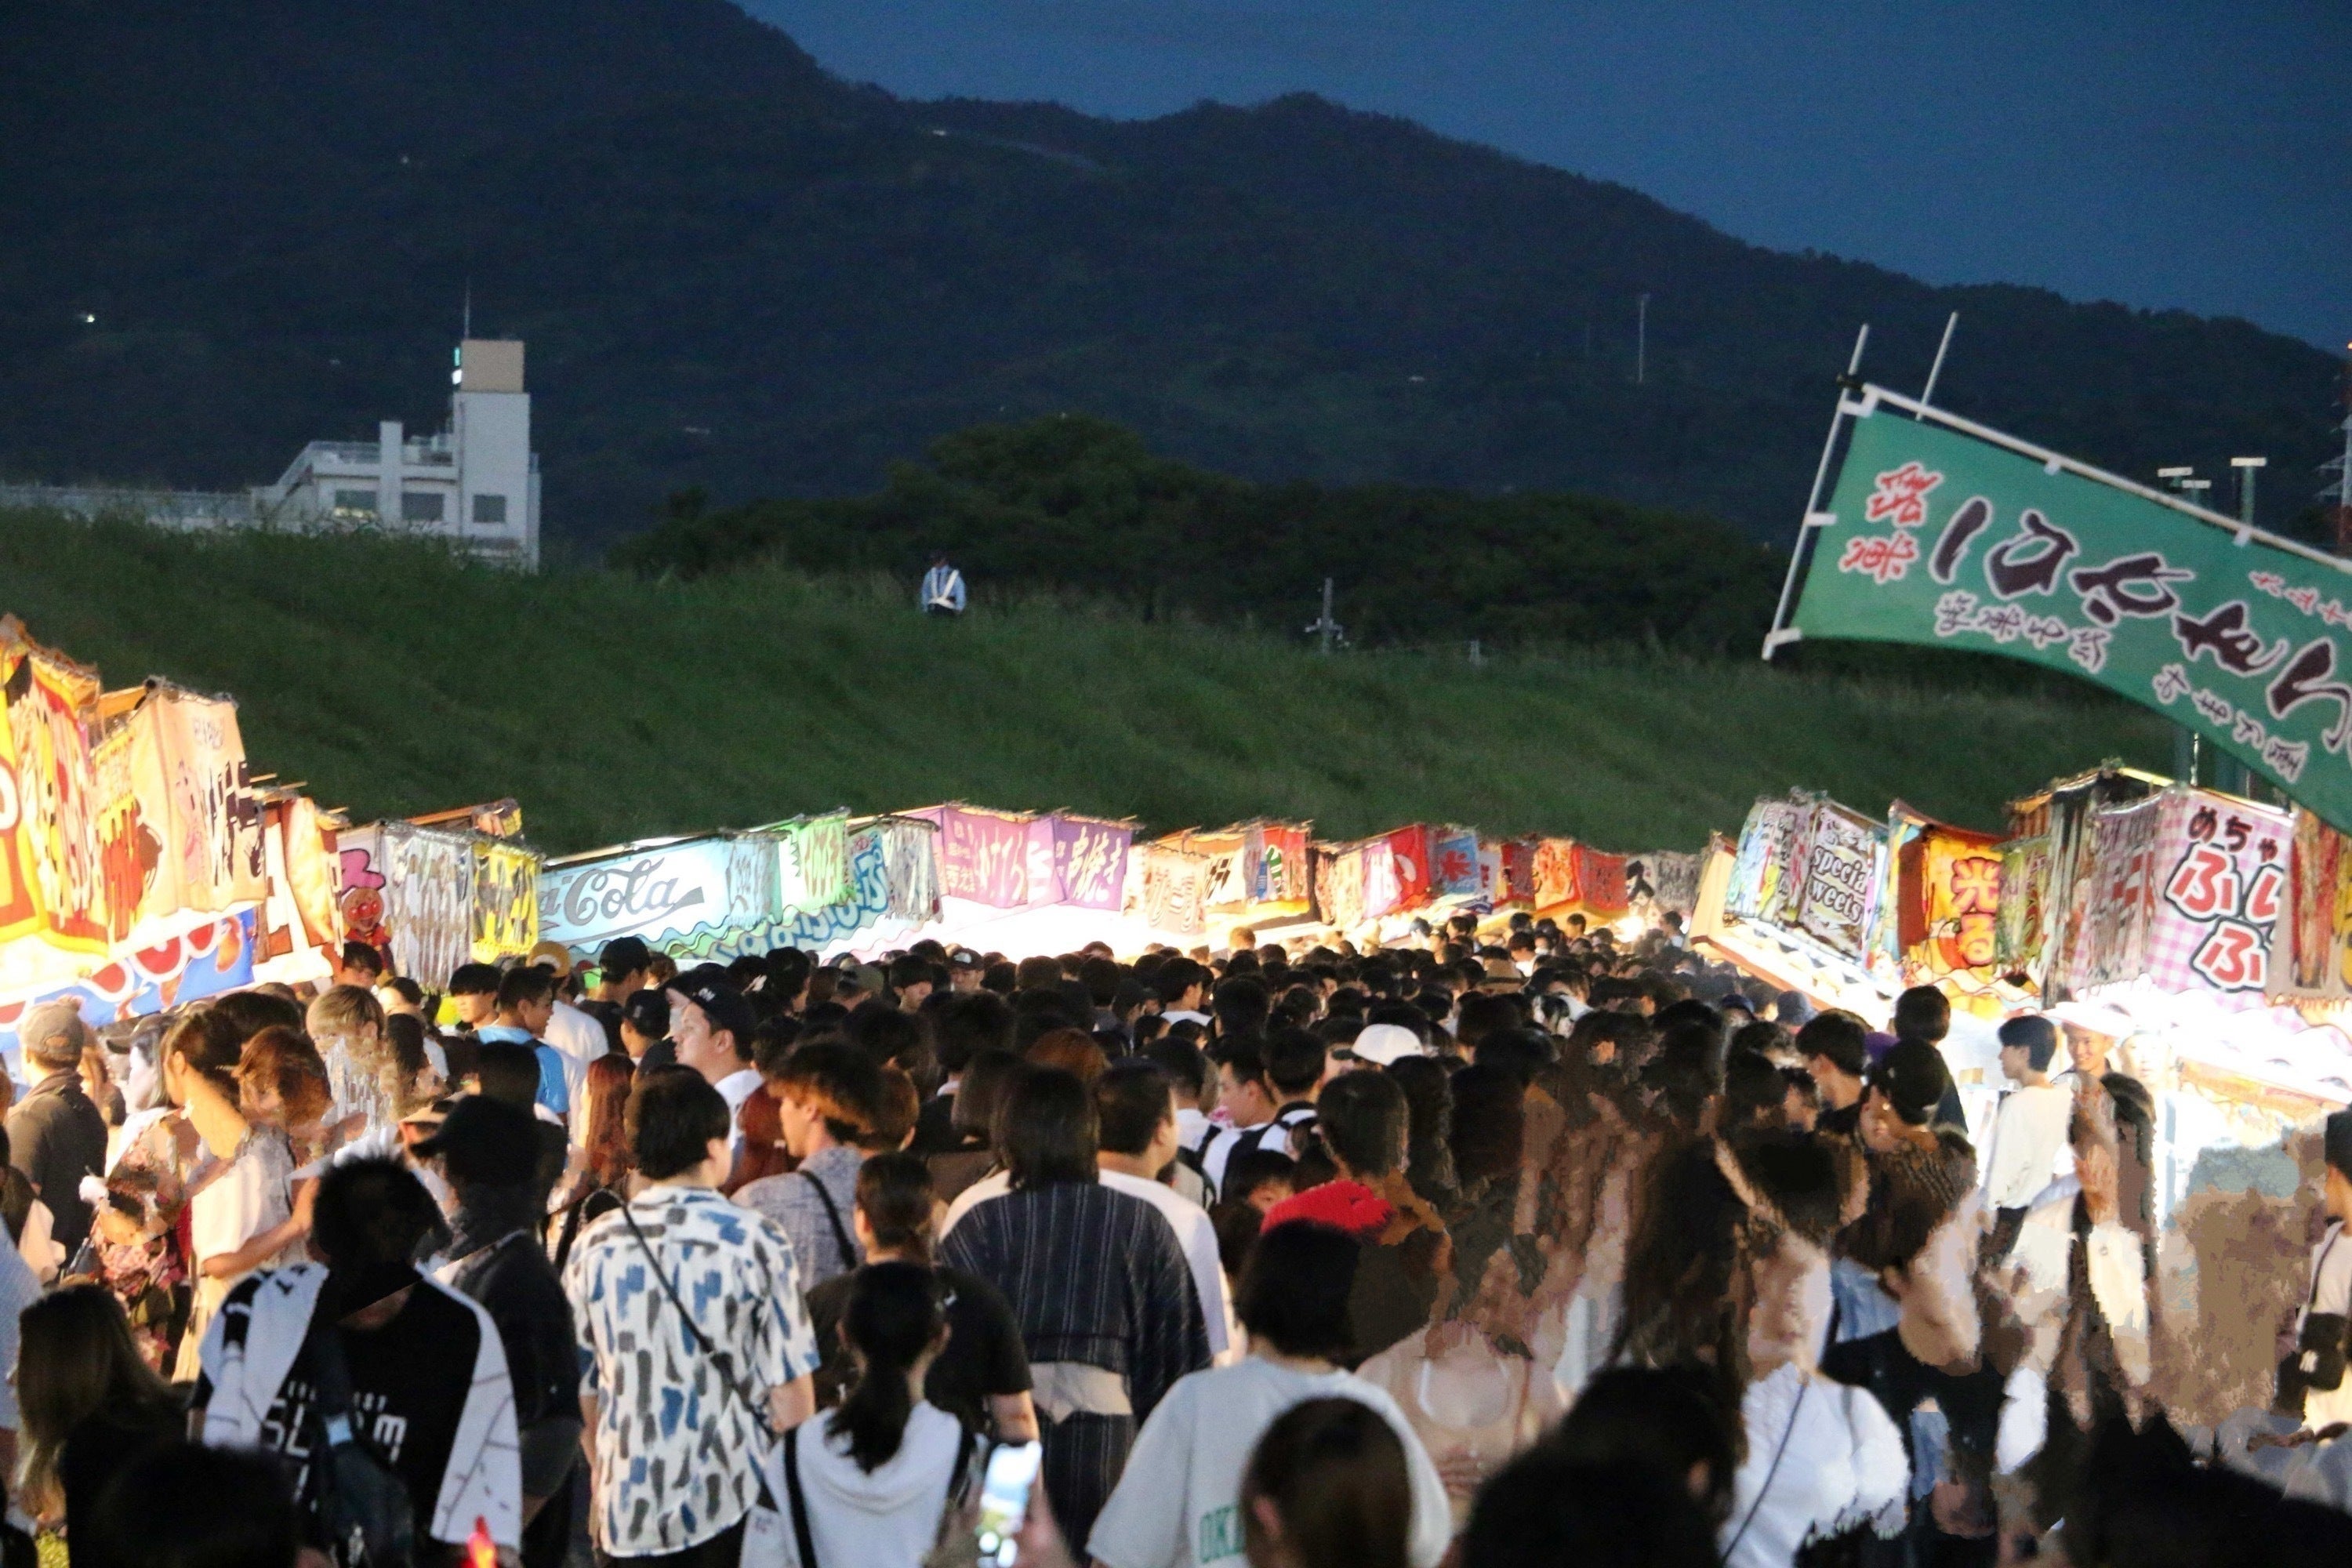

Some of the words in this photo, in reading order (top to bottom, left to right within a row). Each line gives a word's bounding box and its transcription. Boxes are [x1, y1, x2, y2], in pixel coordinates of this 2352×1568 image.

[2188, 805, 2278, 864] めちゃ
[1813, 845, 1867, 895] specia
[1808, 877, 1863, 923] weets
